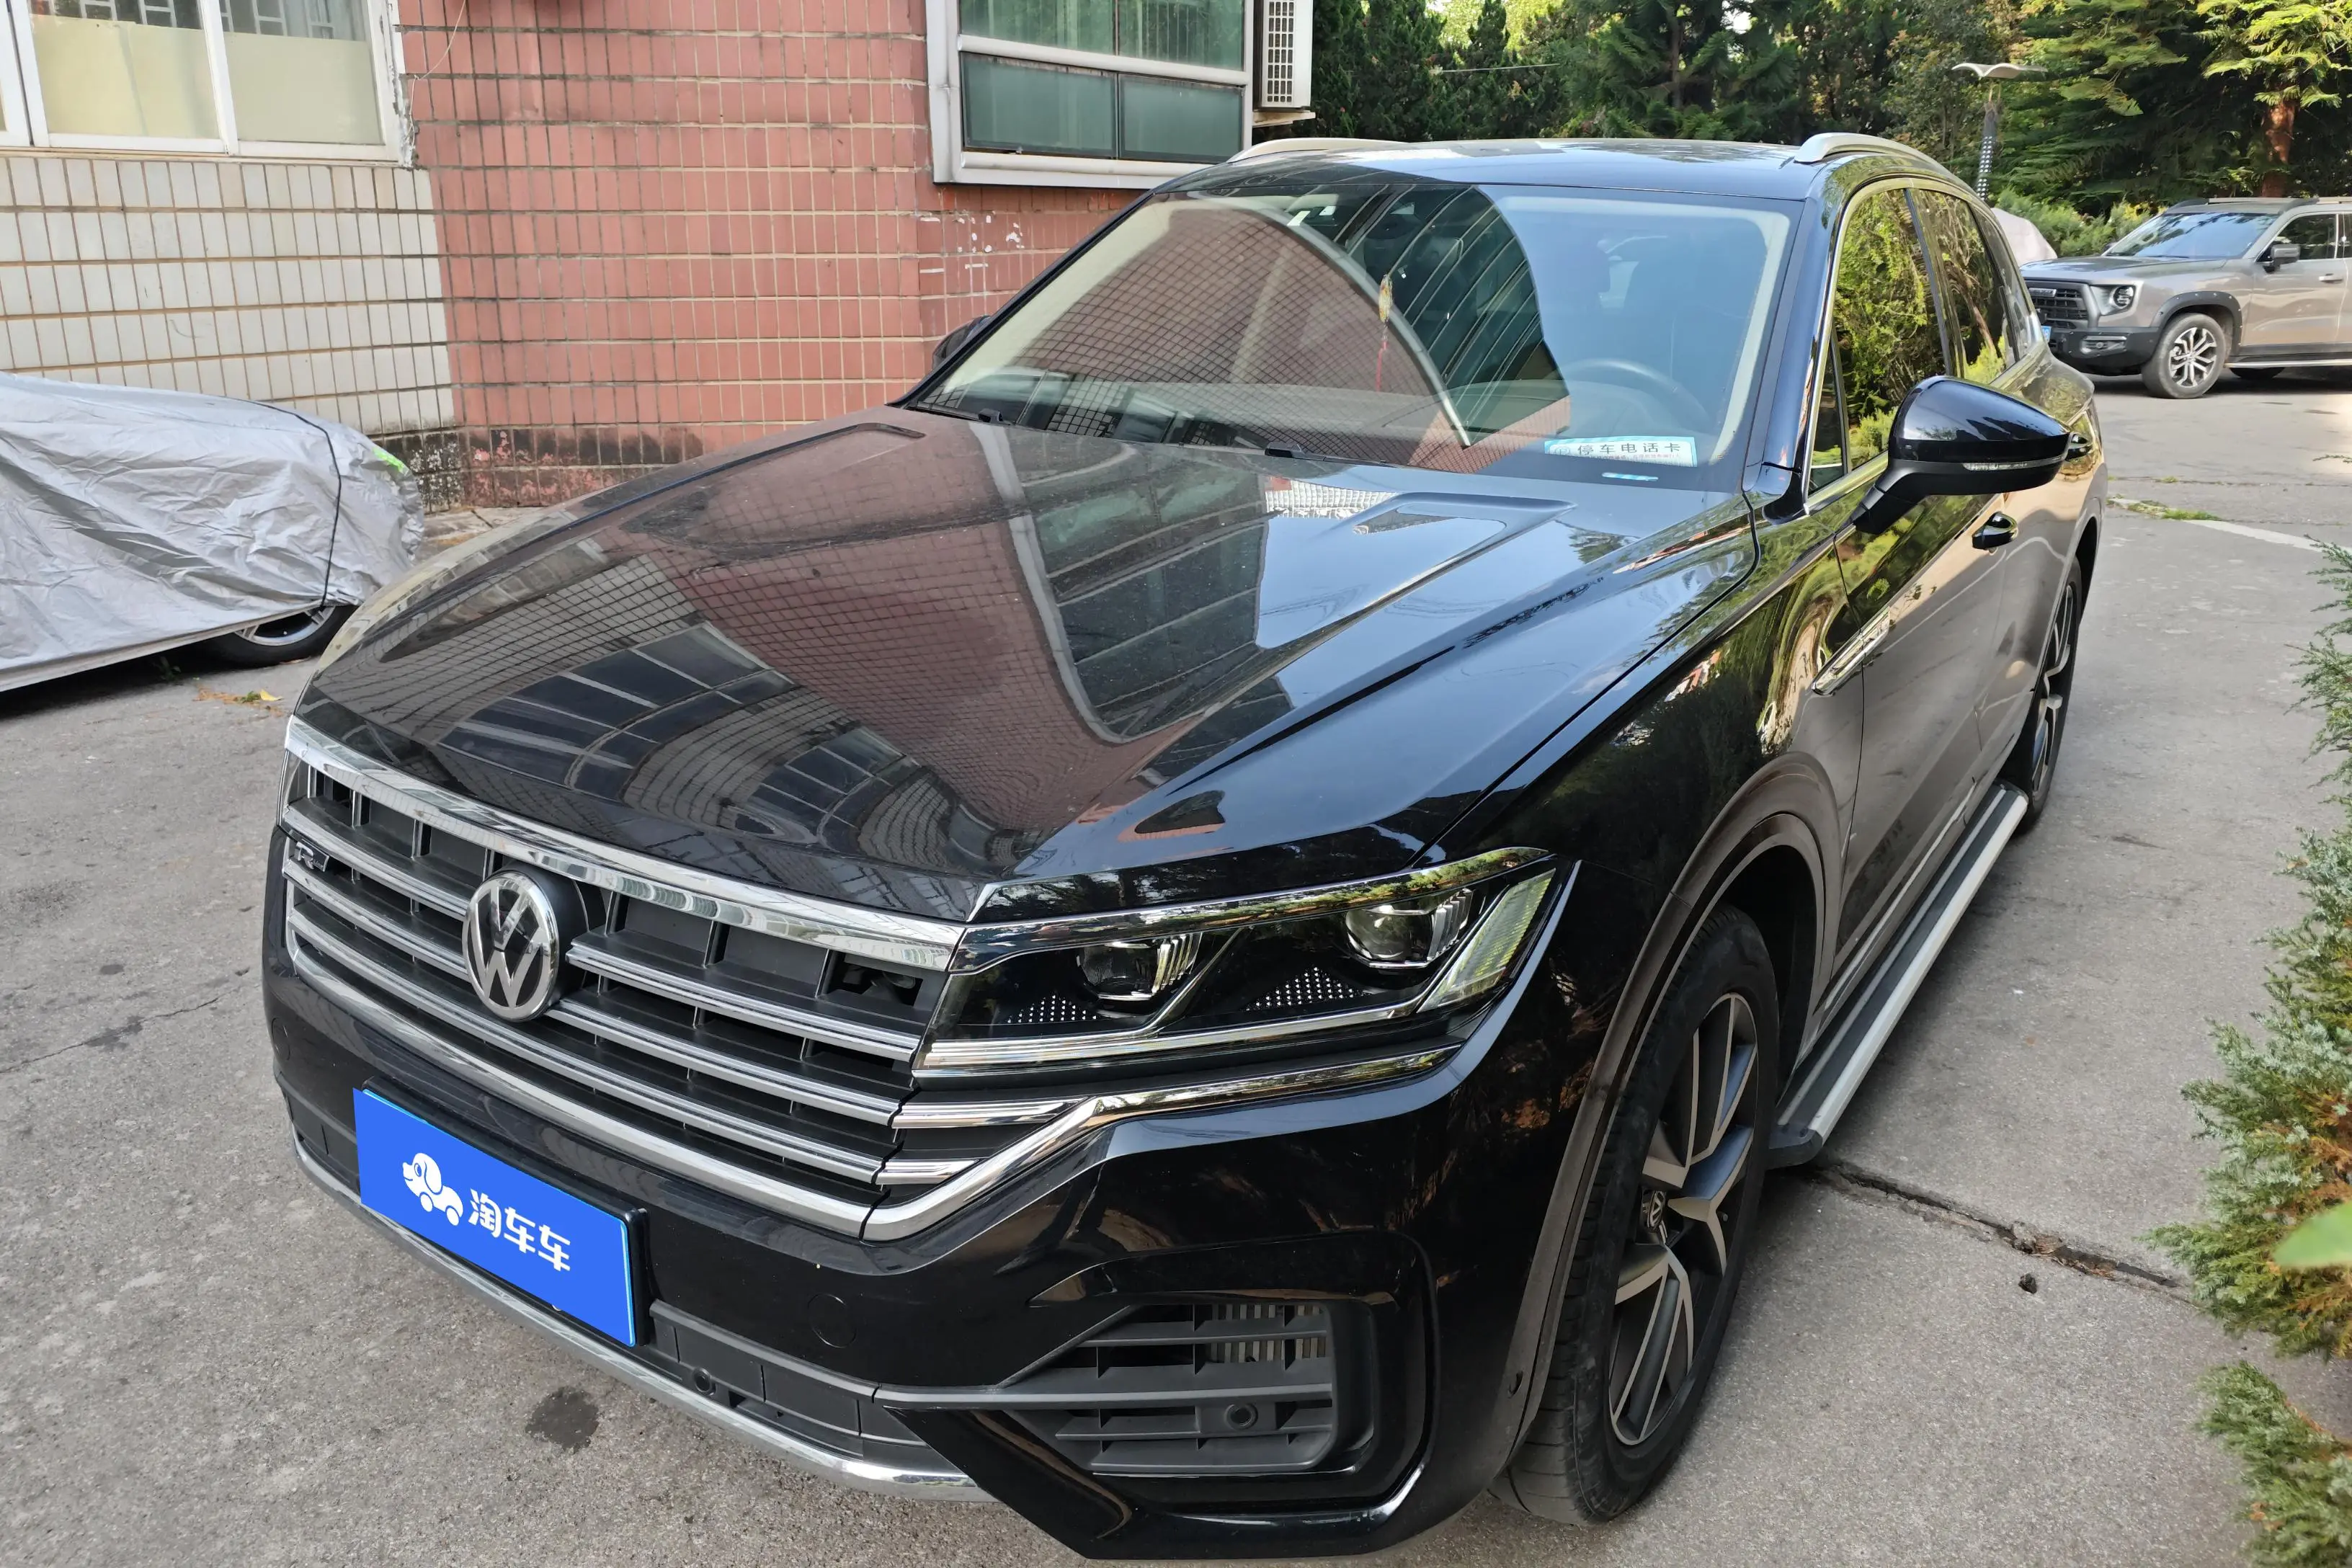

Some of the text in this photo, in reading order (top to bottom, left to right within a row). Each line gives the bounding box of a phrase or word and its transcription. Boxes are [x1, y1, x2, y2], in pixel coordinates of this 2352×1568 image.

[1577, 442, 1681, 455] 停车电话卡
